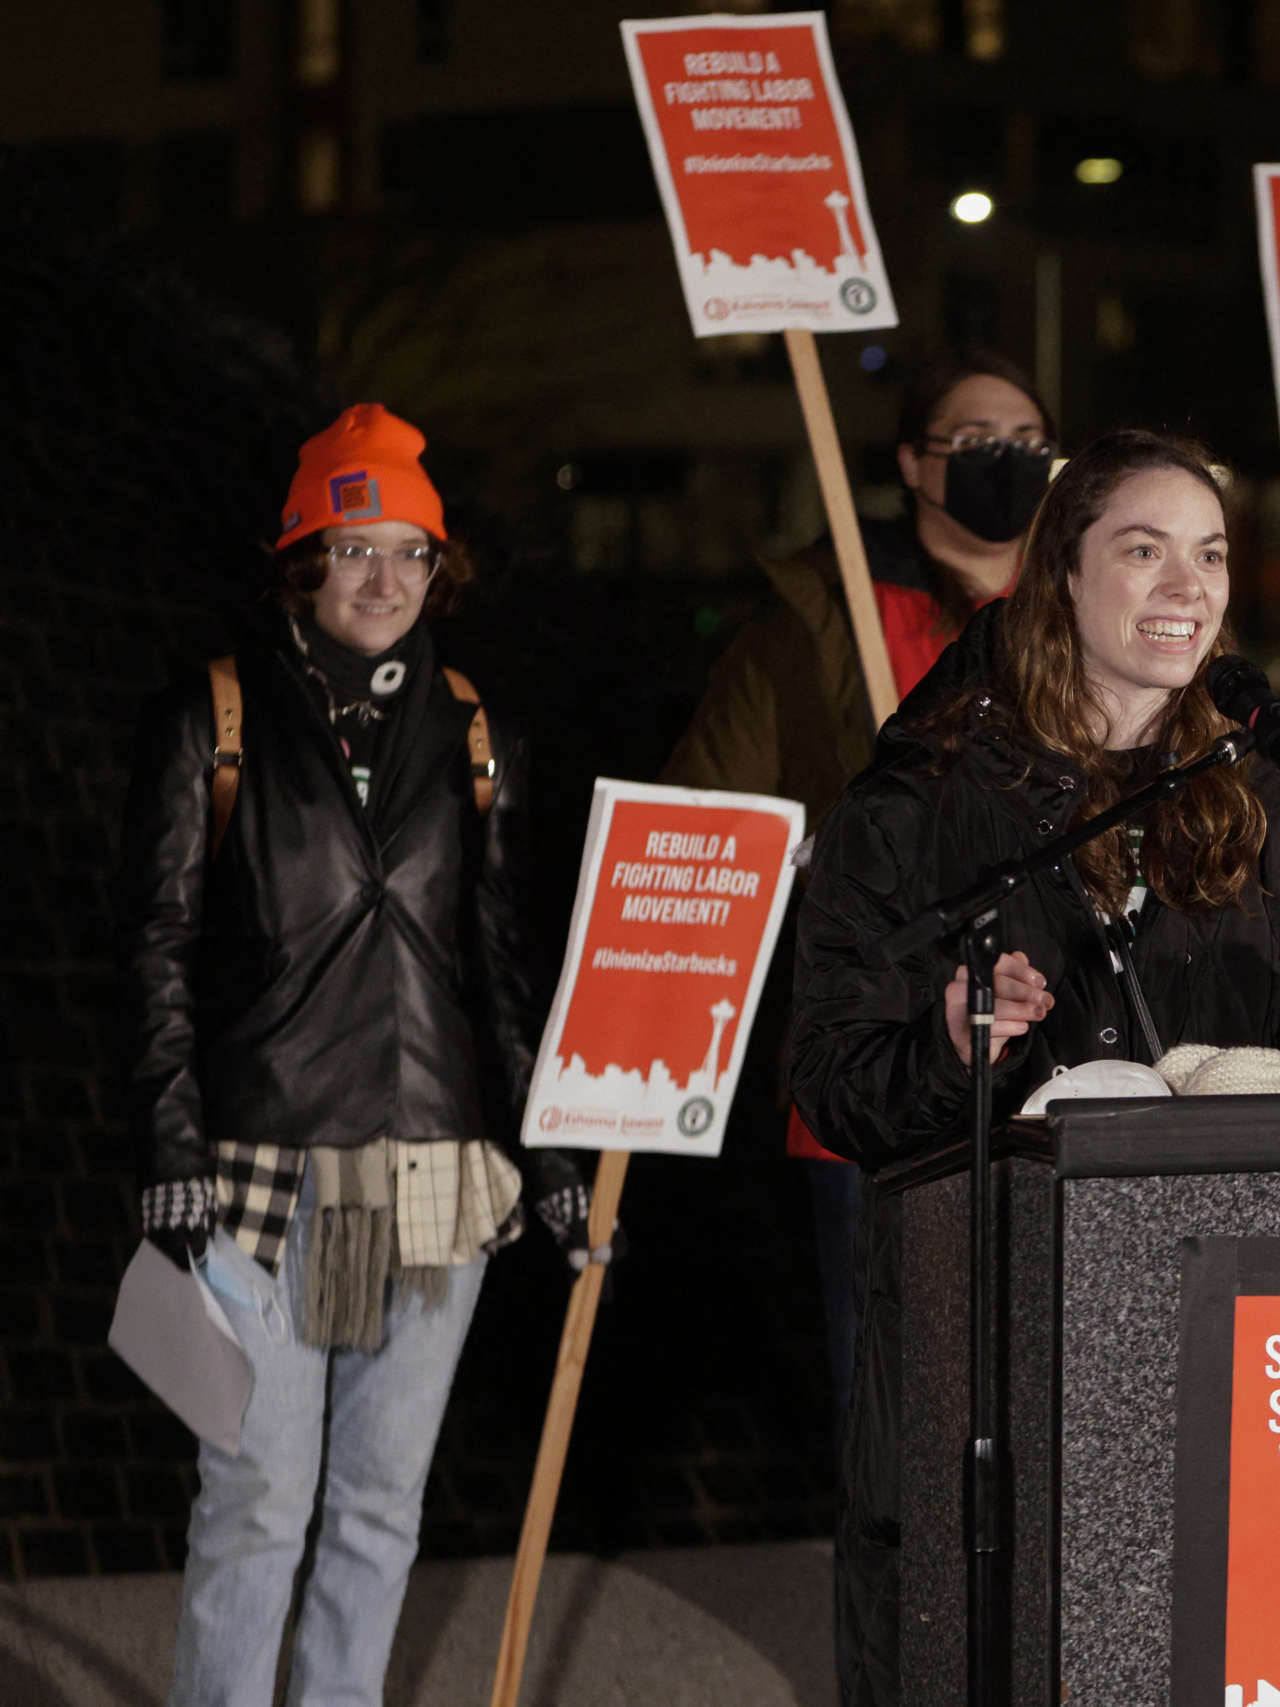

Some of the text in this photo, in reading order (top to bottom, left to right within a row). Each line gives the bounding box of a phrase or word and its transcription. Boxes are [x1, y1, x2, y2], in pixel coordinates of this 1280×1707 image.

[683, 51, 782, 77] REBUILD A
[664, 77, 815, 105] FIGHTING LABOR
[691, 106, 803, 131] MOVEMENT!
[646, 831, 736, 862] REBUILD A
[611, 862, 760, 898] FIGHTING LABOR
[621, 895, 731, 926] MOVEMENT!
[592, 947, 737, 977] #UnionizeStarbucks
